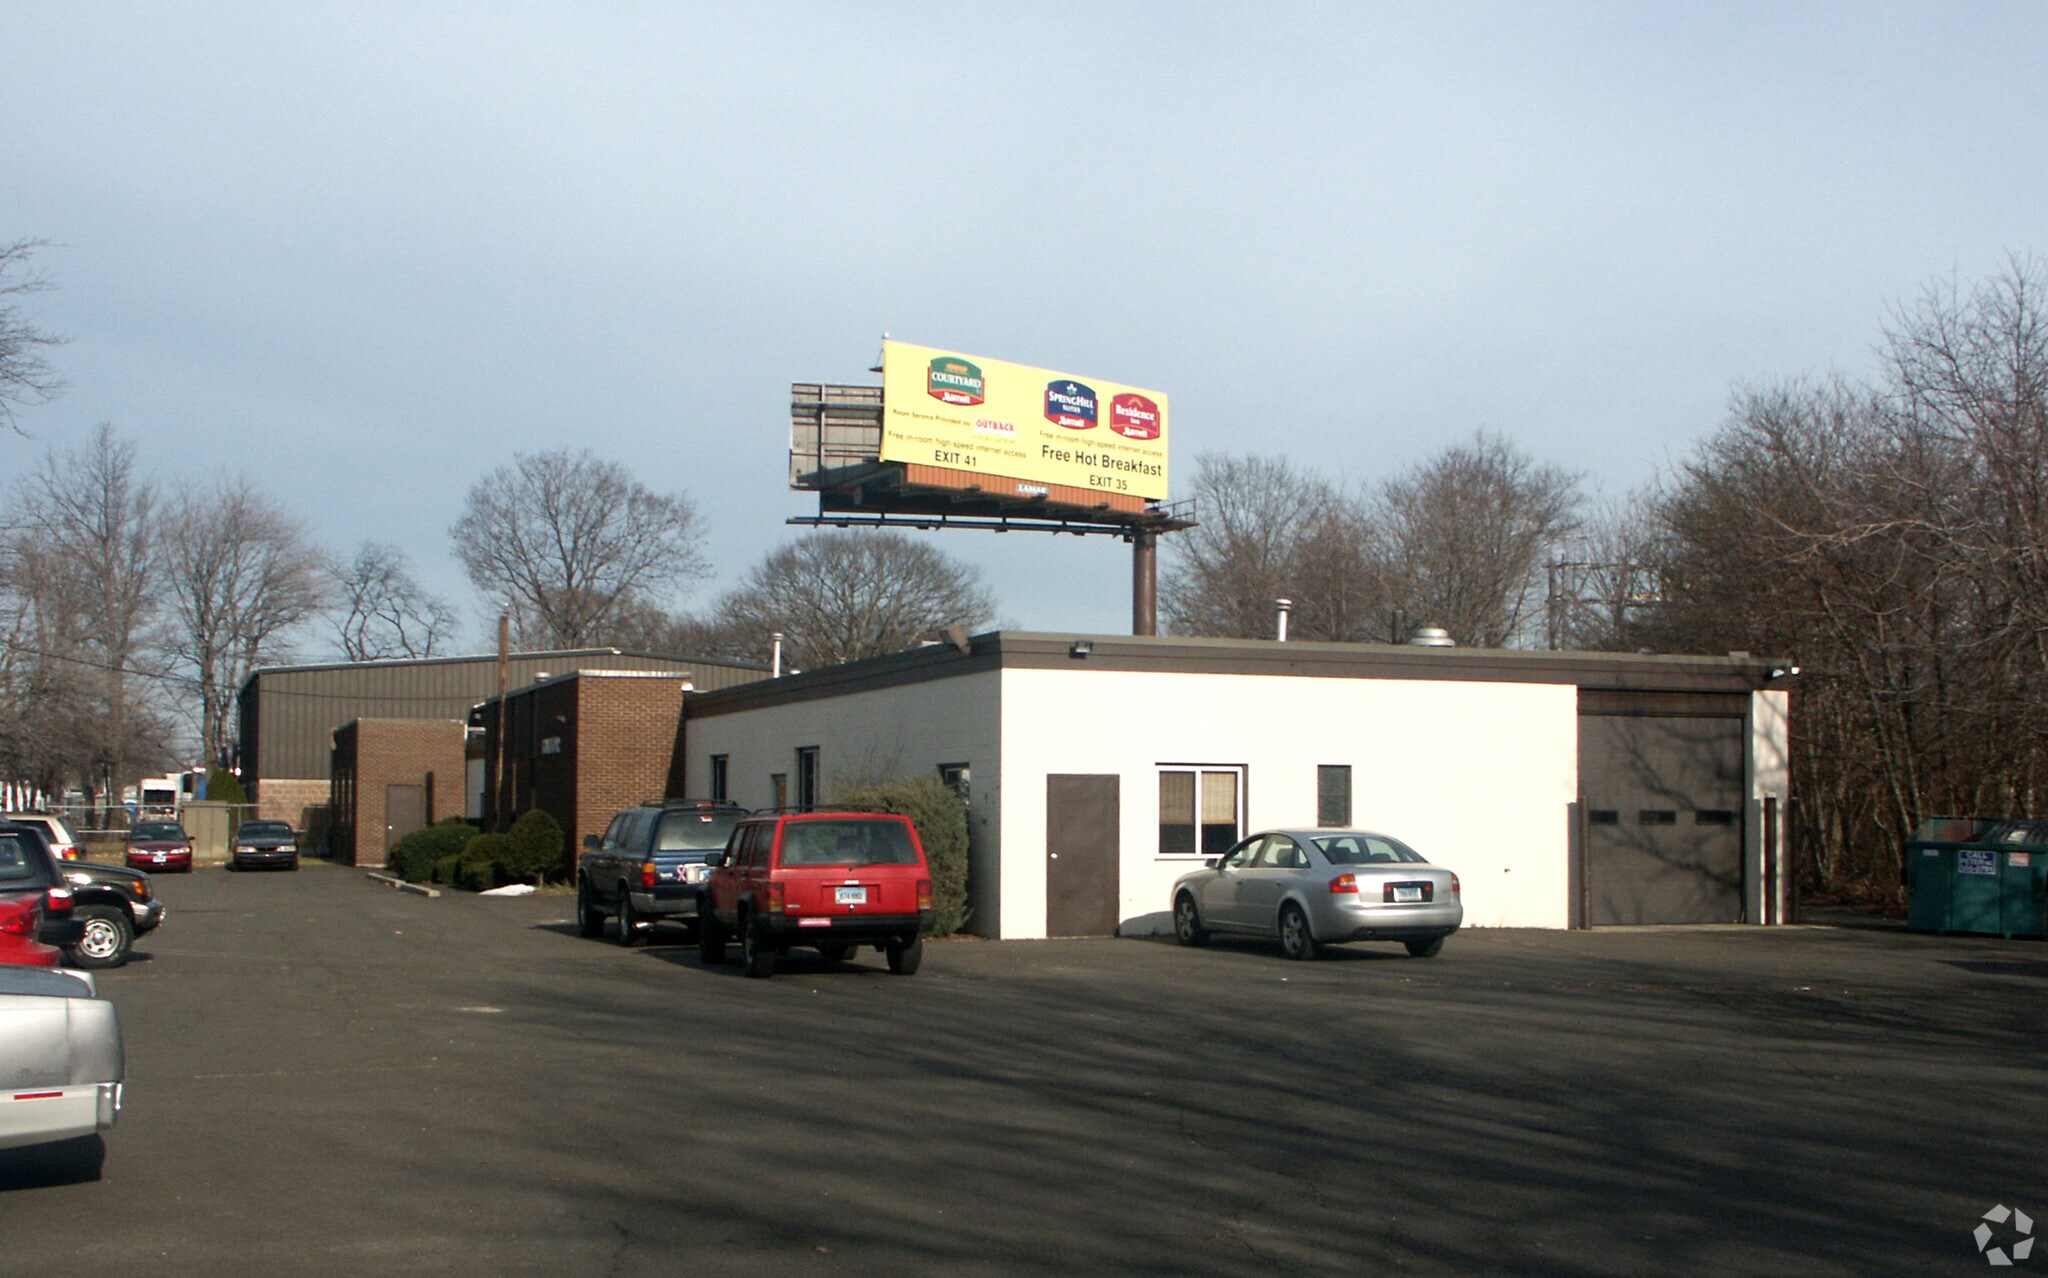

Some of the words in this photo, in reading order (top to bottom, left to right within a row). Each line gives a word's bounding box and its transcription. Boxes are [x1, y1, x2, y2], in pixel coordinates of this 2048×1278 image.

[932, 372, 982, 388] COURTYARD
[893, 408, 910, 416] Room
[912, 411, 934, 420] Service
[936, 415, 962, 425] Provided
[1115, 404, 1155, 421] Residence
[976, 419, 1014, 432] OUTBACK
[1040, 430, 1053, 439] Free
[888, 430, 904, 440] Free
[1004, 449, 1027, 459] access
[934, 449, 961, 464] EXIT
[964, 455, 977, 467] 41
[1042, 444, 1071, 462] Free
[1075, 450, 1098, 467] Hot
[1102, 454, 1162, 477] Breakfast
[1089, 474, 1112, 488] EXIT
[1116, 478, 1128, 491] 35
